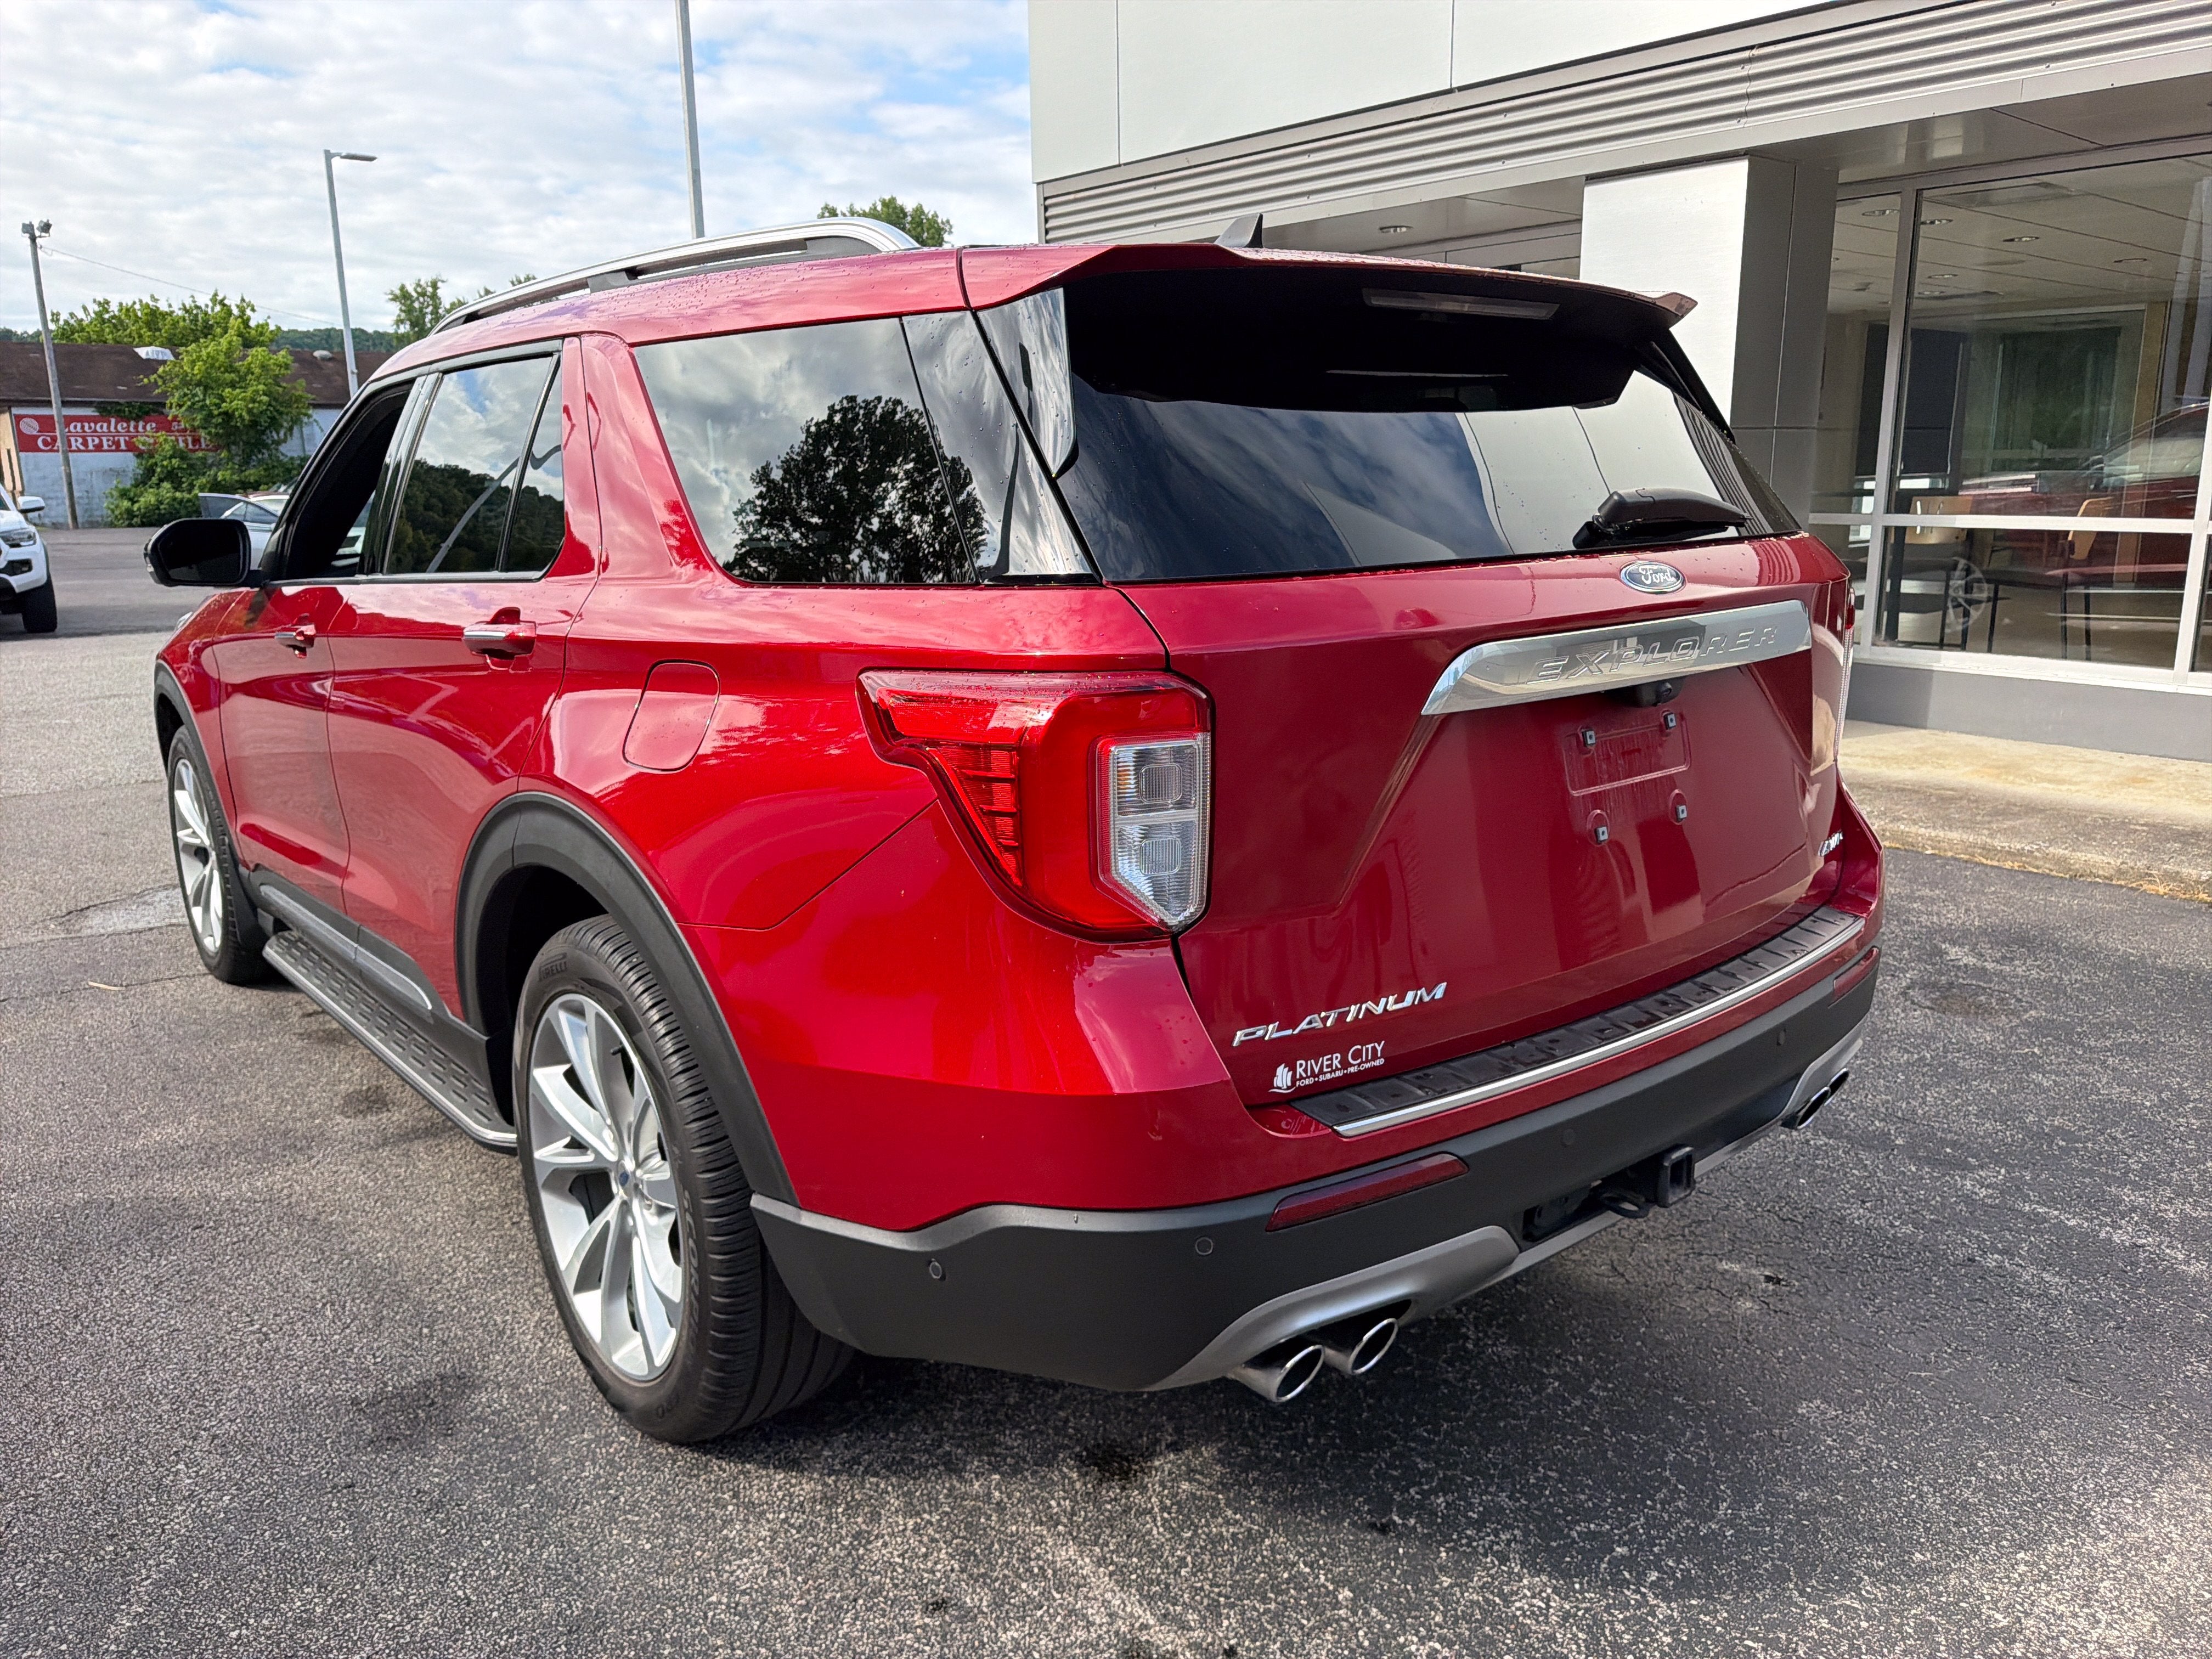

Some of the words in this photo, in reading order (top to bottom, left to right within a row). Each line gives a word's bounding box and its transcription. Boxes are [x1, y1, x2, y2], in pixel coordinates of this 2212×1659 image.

[1639, 565, 1675, 584] Ford
[1526, 625, 1778, 685] EXPLORER
[1232, 981, 1447, 1047] PLATINUM
[1296, 1053, 1341, 1079] RIVER
[1348, 1040, 1385, 1064] CITY
[1296, 1077, 1314, 1088] FORD
[1319, 1069, 1344, 1082] SUBARU
[1347, 1058, 1385, 1074] PRE-OWNED
